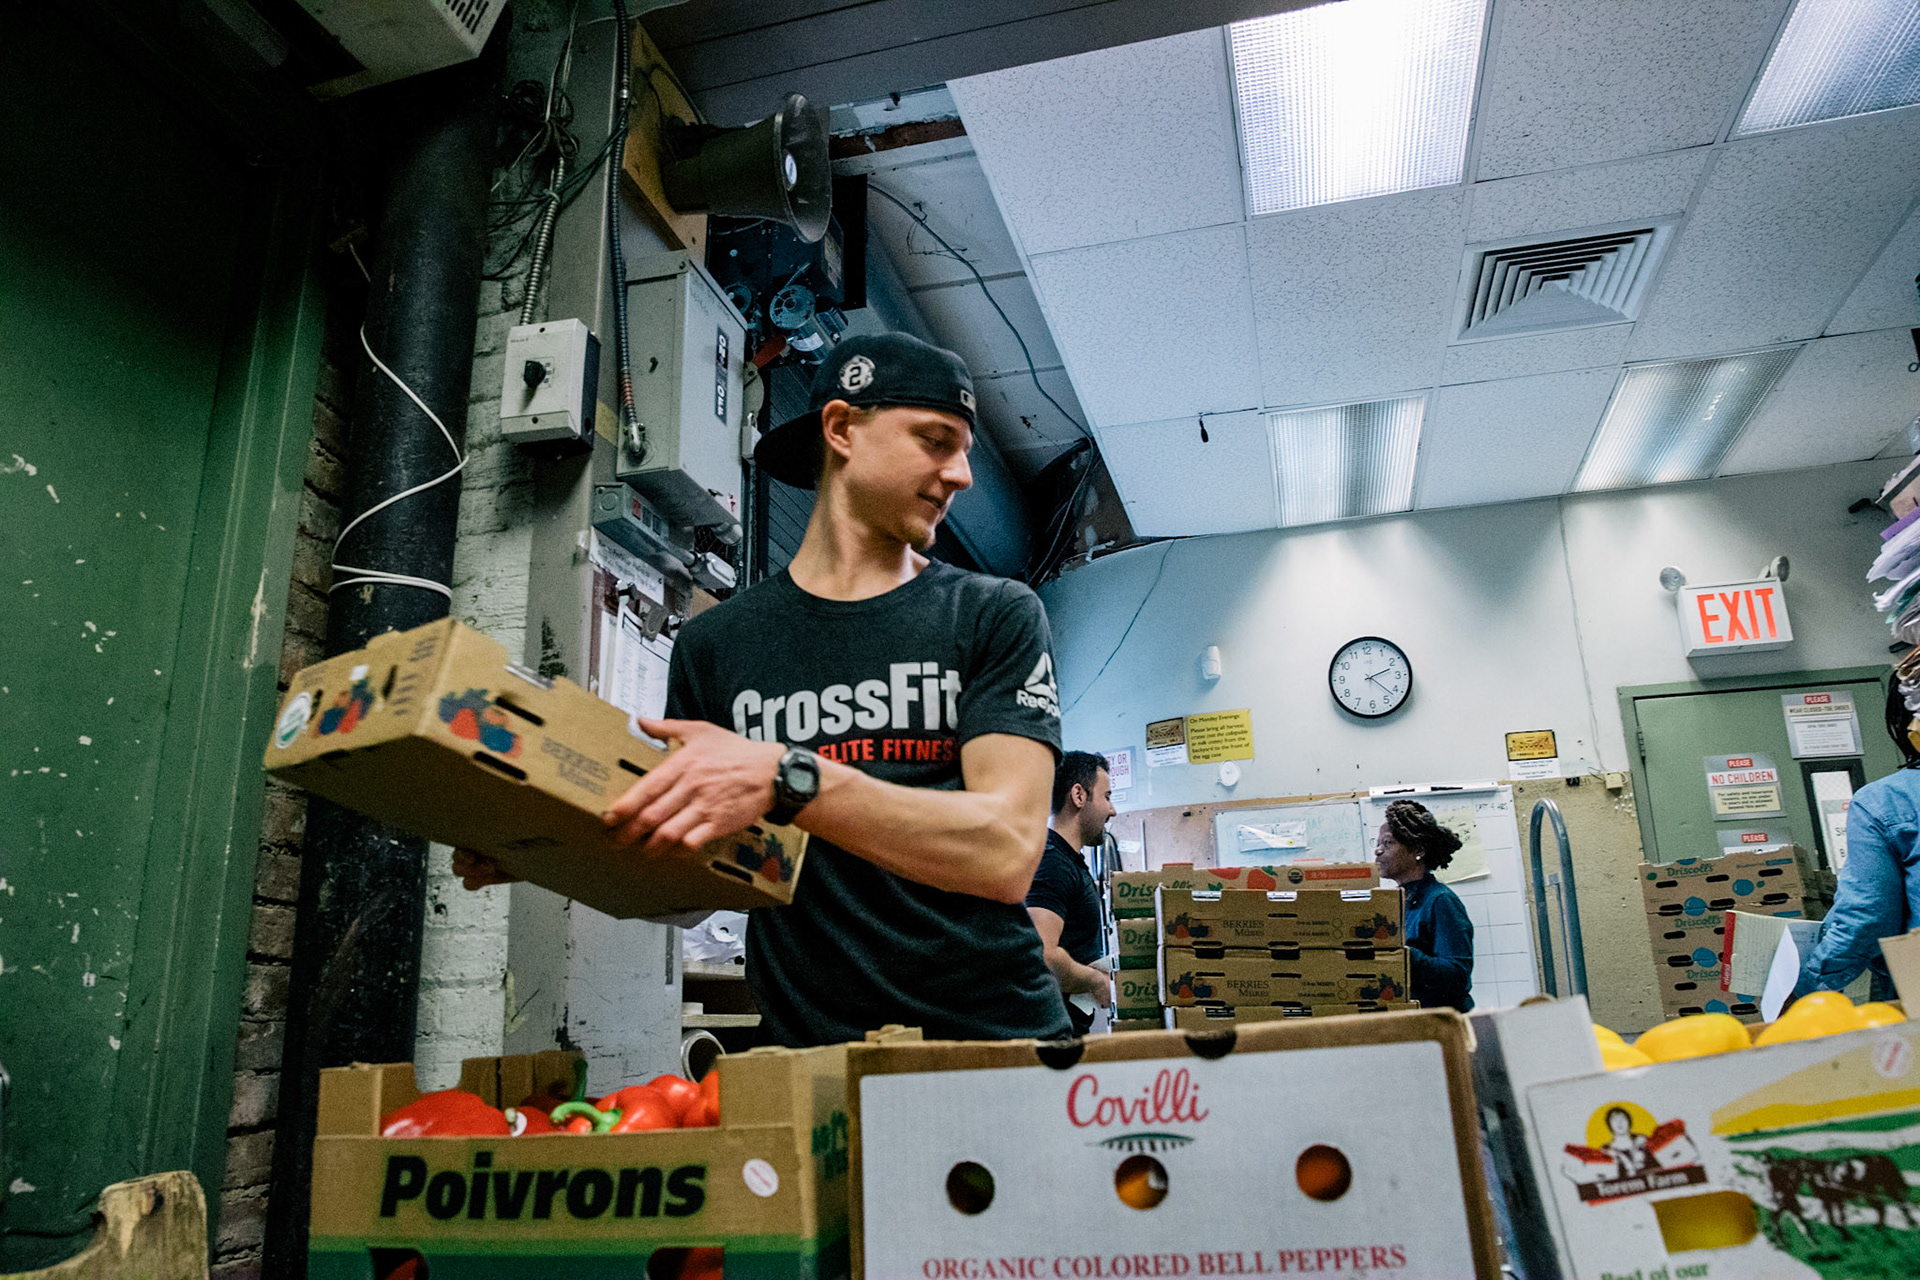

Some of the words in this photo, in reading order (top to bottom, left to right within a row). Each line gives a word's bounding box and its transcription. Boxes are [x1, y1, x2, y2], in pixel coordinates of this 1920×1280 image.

[849, 365, 862, 387] 2
[717, 385, 725, 416] OFF
[1696, 588, 1778, 644] EXIT
[1350, 652, 1358, 660] 11
[1362, 646, 1372, 655] 12
[1340, 662, 1350, 670] 10
[1388, 658, 1394, 666] 2
[1339, 676, 1346, 684] 9
[1394, 670, 1401, 680] 3
[1344, 688, 1350, 698] 8
[732, 661, 962, 742] CrossFit
[1016, 689, 1060, 718] Reebo
[1355, 698, 1362, 706] 7
[1370, 700, 1376, 708] 6
[1383, 696, 1390, 704] 5
[818, 738, 874, 764] ELITE
[882, 738, 954, 761] FITNES
[1712, 774, 1725, 784] NO
[1727, 771, 1774, 783] CHILDREN
[1666, 864, 1714, 876] Driscoll's
[1223, 920, 1264, 928] BERRIES
[1674, 915, 1721, 928] Driscoll's
[1686, 970, 1720, 979] Drisco
[1227, 980, 1269, 988] BERRIES
[1067, 1067, 1209, 1128] Covilli
[380, 1150, 707, 1220] Poivrons
[922, 1256, 1048, 1280] ORGANIC
[1053, 1253, 1190, 1278] COLORED
[1199, 1250, 1274, 1275] BELL
[1279, 1245, 1407, 1273] PEPPERS
[1650, 1264, 1669, 1280] of
[1676, 1263, 1709, 1279] our
